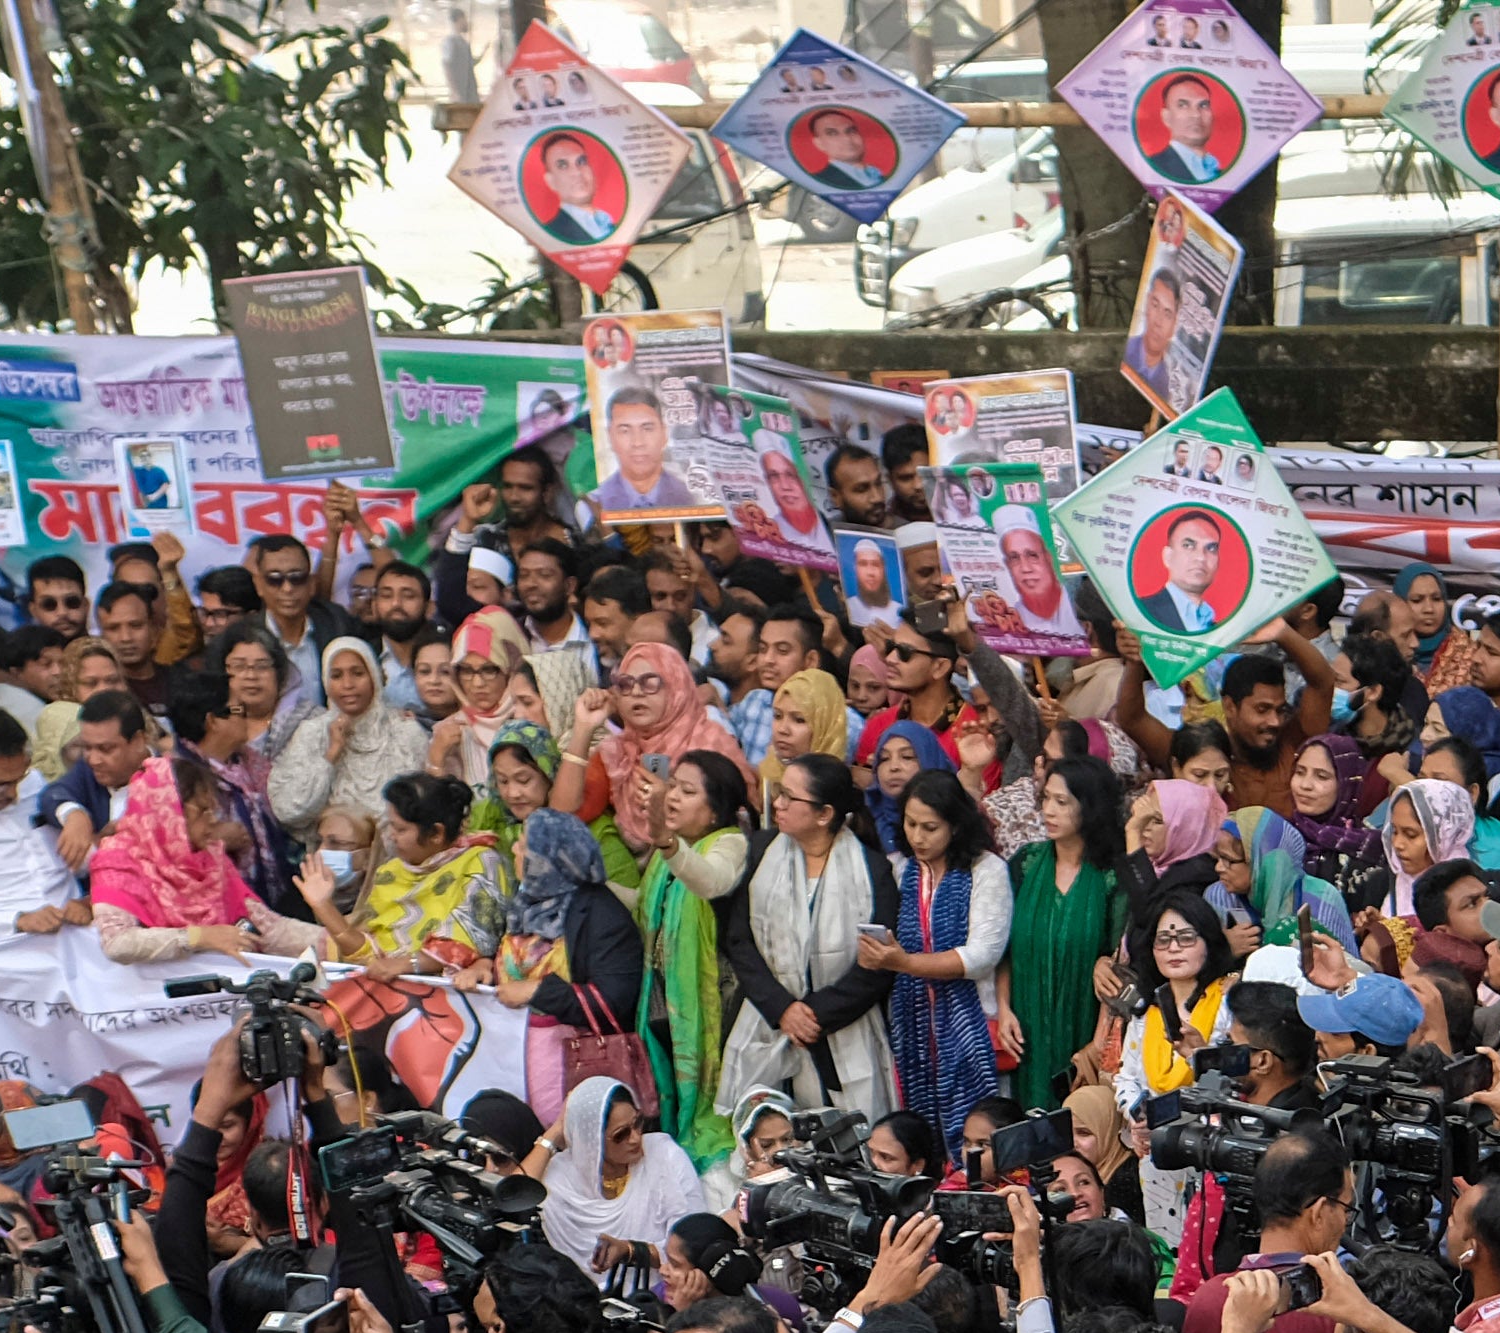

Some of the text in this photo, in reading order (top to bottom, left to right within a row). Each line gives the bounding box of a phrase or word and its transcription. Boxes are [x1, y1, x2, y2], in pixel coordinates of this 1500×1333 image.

[96, 366, 213, 415] আন্তর্জাতিক
[1133, 475, 1180, 493] দেশনেত্রী
[1183, 483, 1211, 501] বেগম
[1215, 491, 1251, 510] খালেদা
[1377, 482, 1479, 515] শাসন
